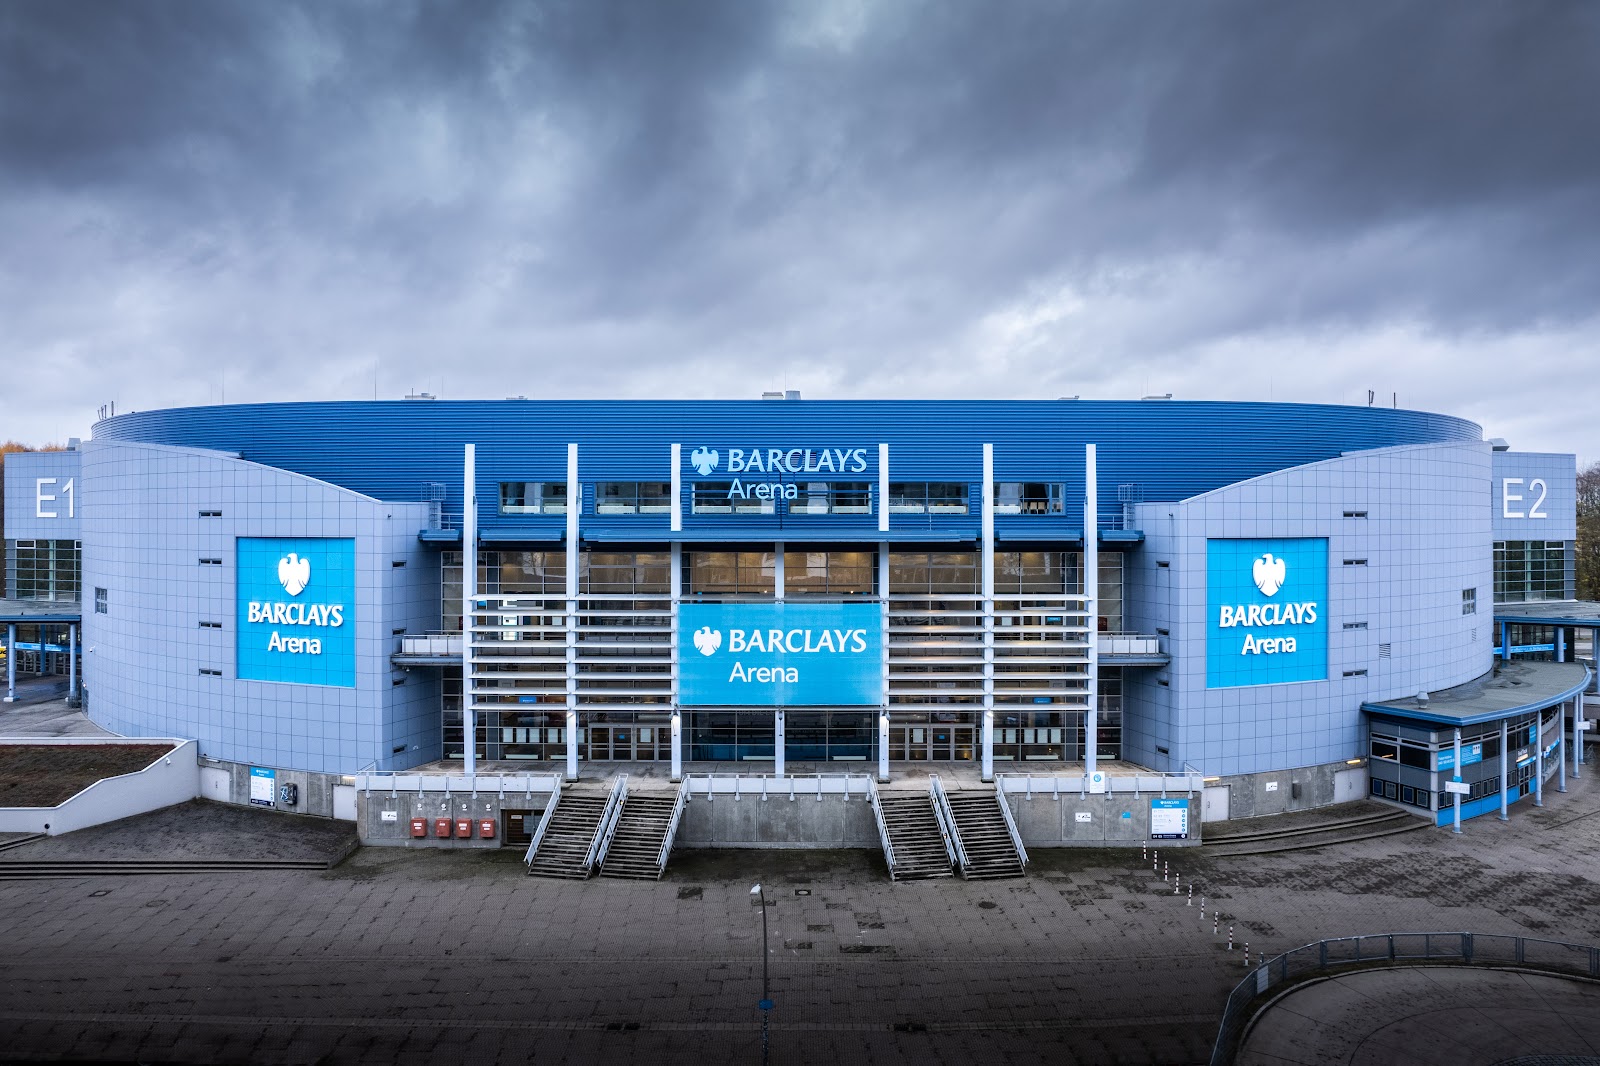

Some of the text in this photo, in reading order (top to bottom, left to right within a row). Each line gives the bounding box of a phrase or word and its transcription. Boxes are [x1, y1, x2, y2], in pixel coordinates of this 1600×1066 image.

[727, 448, 867, 473] BARCLAYS
[36, 478, 74, 518] E1
[727, 478, 798, 500] Arena
[1503, 478, 1547, 518] E2
[247, 601, 345, 628] BARCLAYS
[1219, 601, 1318, 628] BARCLAYS
[267, 631, 322, 656] Arena
[729, 628, 867, 653] BARCLAYS
[1241, 633, 1297, 656] Arena
[729, 661, 798, 683] Arena
